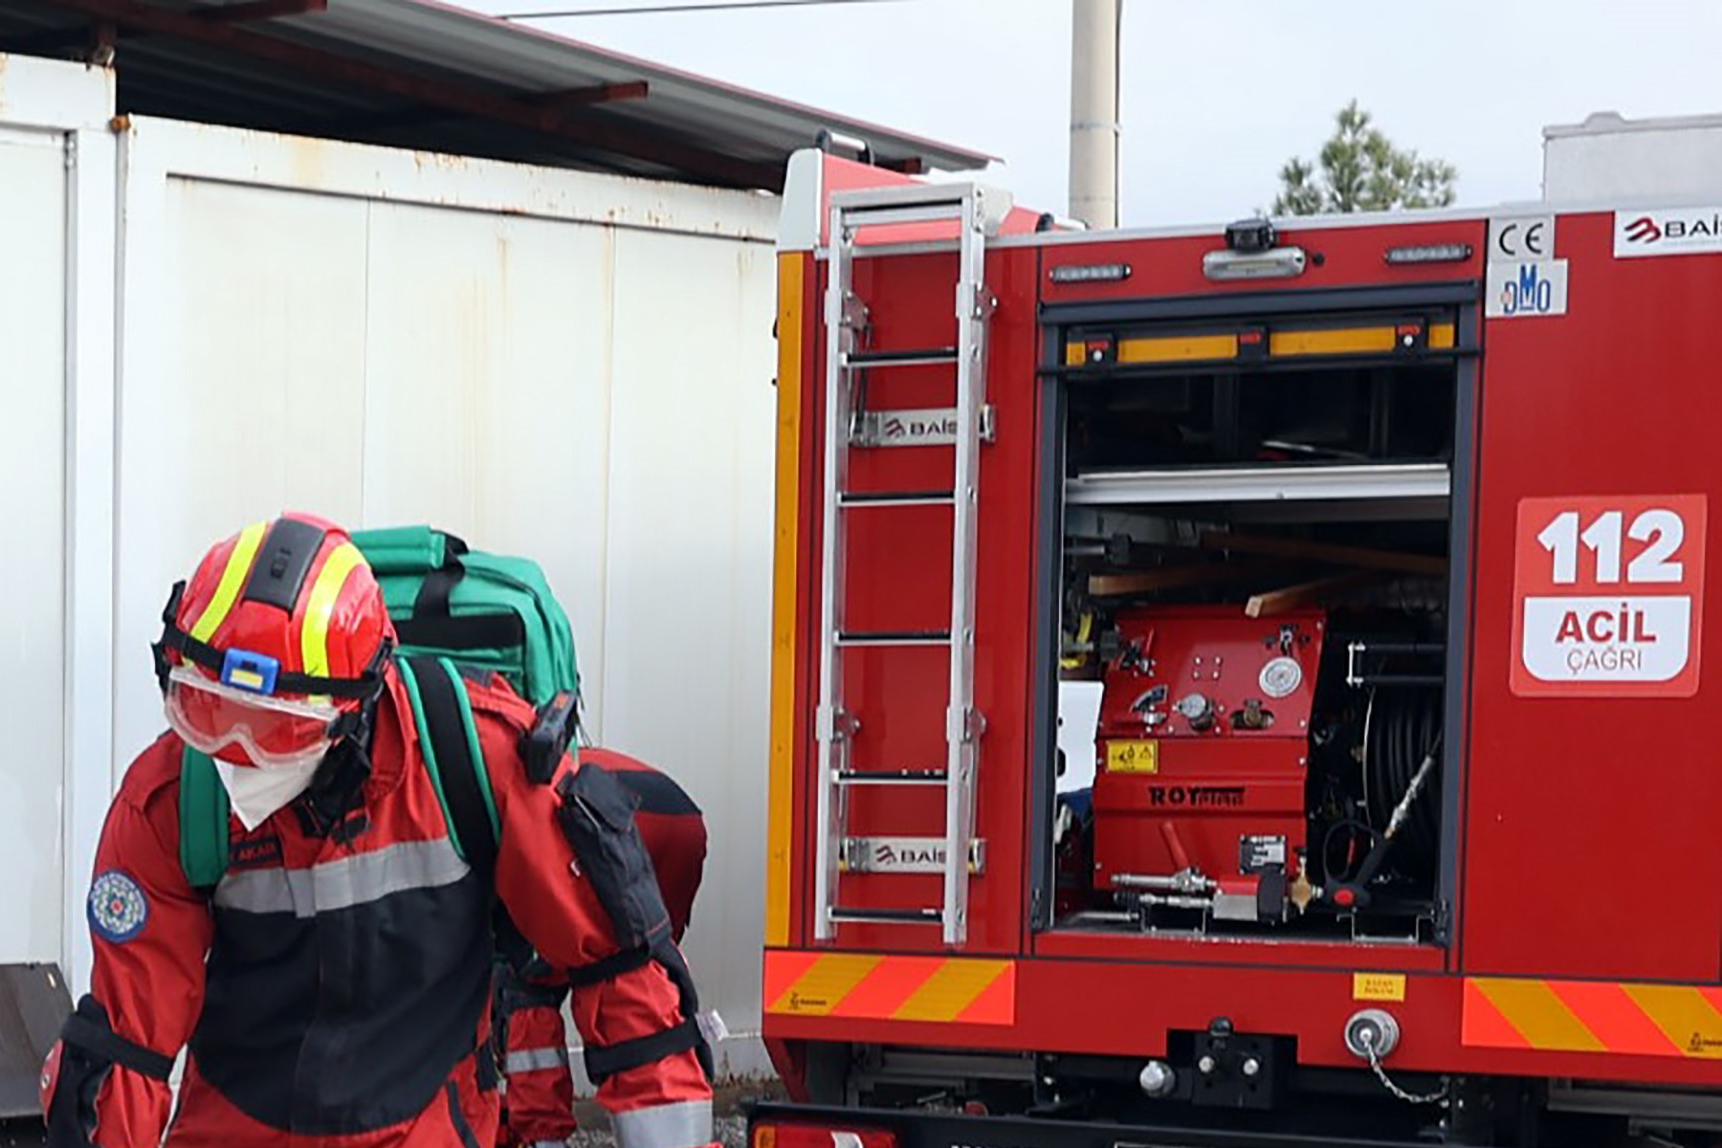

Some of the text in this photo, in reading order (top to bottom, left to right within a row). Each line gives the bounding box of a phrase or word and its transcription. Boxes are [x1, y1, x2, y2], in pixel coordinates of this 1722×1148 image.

[1499, 223, 1543, 255] CE
[1665, 214, 1722, 238] BAİ
[1503, 264, 1551, 314] DMO
[1537, 508, 1684, 583] 112
[1555, 602, 1656, 643] ACİL
[1566, 646, 1642, 676] ÇAĞRI
